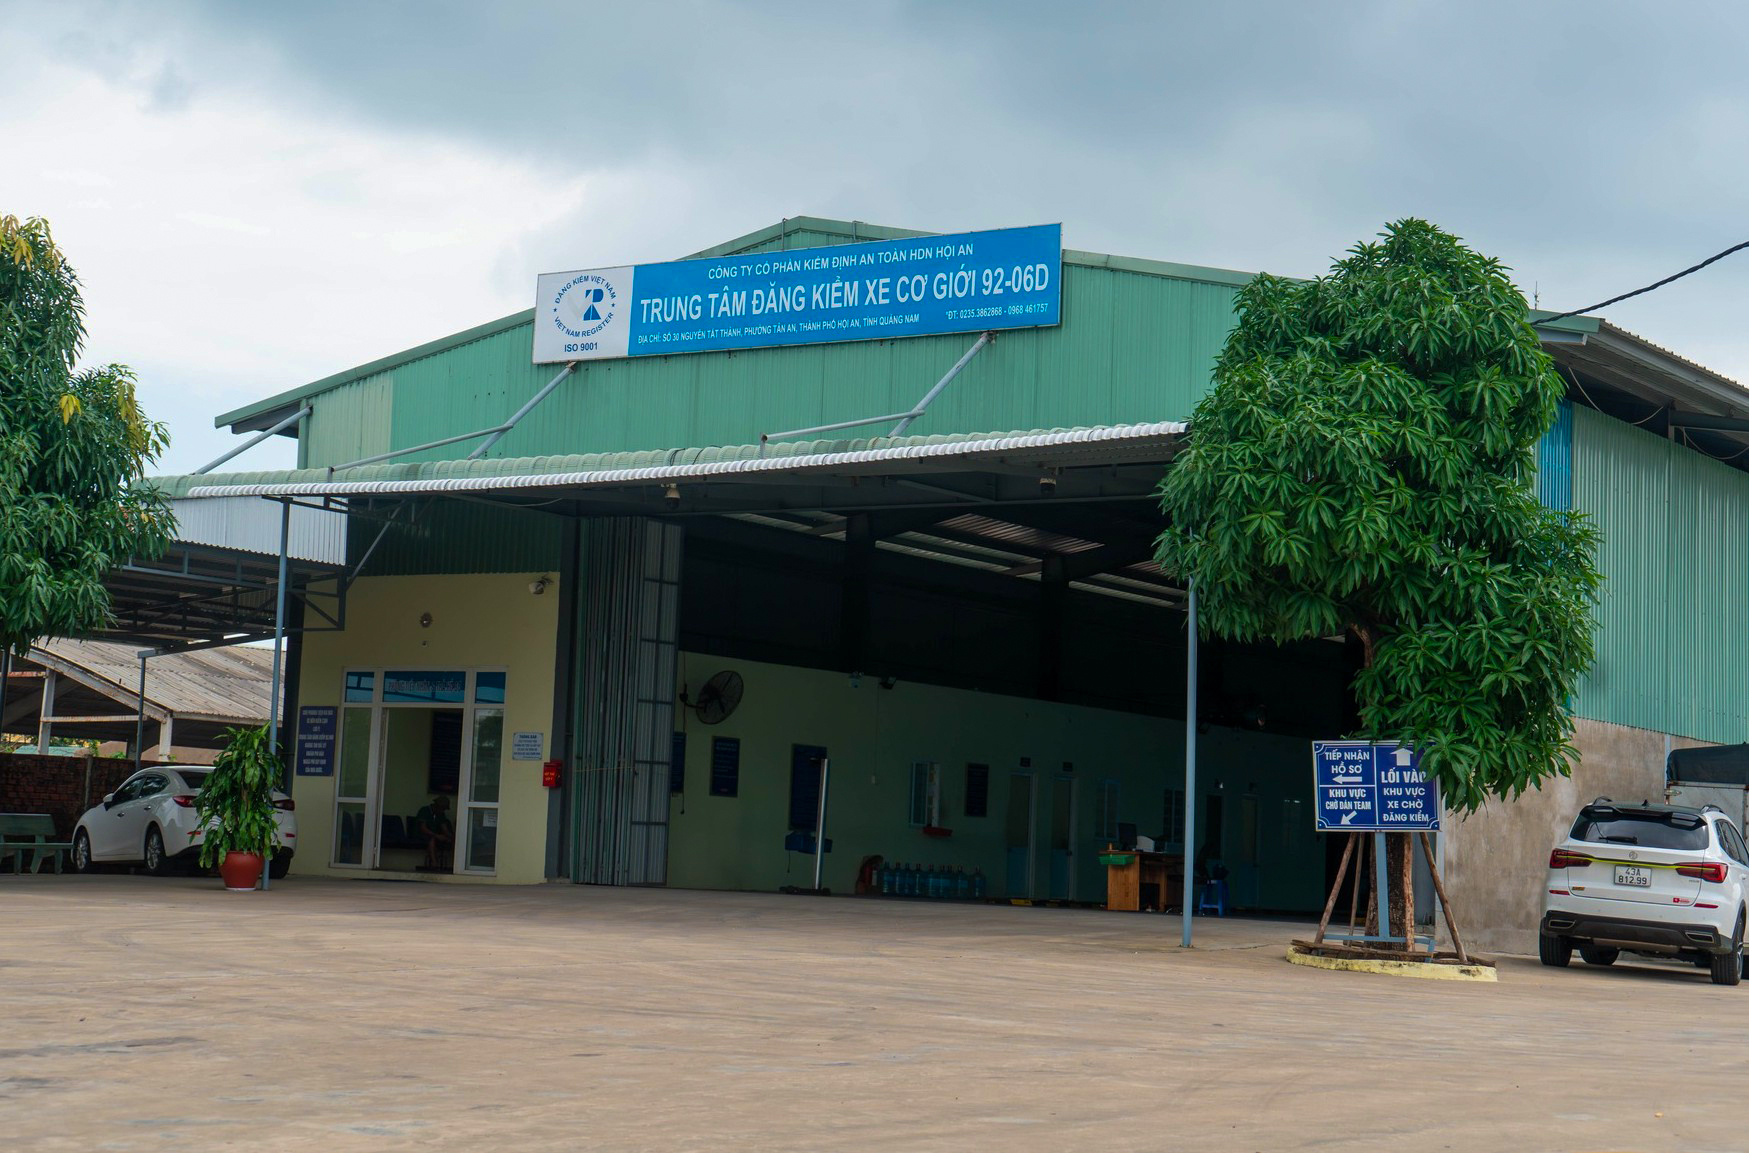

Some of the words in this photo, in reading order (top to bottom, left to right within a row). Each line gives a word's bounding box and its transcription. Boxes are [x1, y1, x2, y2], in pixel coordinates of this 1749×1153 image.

[709, 265, 737, 280] CÔNG
[741, 264, 753, 276] TY
[832, 254, 857, 270] ĐỊNH
[859, 253, 874, 266] AN
[878, 248, 907, 264] TOÀN
[910, 247, 933, 260] HDN
[936, 244, 955, 260] HỘI
[958, 244, 974, 256] AN
[604, 282, 617, 300] NAM
[640, 294, 702, 324] TRUNG
[708, 285, 747, 318] TÂM
[752, 281, 806, 314] ĐĂNG
[812, 276, 859, 310] KIỂM
[864, 278, 891, 306] XE
[896, 274, 928, 303] CƠ
[933, 263, 976, 300] GIỚI
[982, 264, 1049, 296] 92-06D
[1008, 304, 1024, 315] 0968
[1025, 303, 1048, 313] 461757
[566, 328, 580, 337] NAM
[582, 312, 614, 338] REGISTER
[672, 332, 680, 342] 30
[839, 319, 849, 330] HỘI
[904, 314, 920, 324] NAM
[564, 343, 578, 352] ISO
[580, 342, 598, 351] 9001
[1325, 748, 1342, 760] TIẾP
[1344, 750, 1370, 762] NHẬN
[1331, 760, 1346, 774] HỒ
[1348, 764, 1362, 774] SƠ
[1381, 767, 1400, 784] LỐI
[1329, 788, 1347, 798] KHU
[1348, 788, 1366, 800] VỰC
[1383, 788, 1402, 796] KHU
[1404, 787, 1426, 798] VỰC
[1326, 799, 1338, 810] CHỜ
[1354, 801, 1372, 810] TEAM
[1387, 801, 1400, 809] XE
[1401, 799, 1424, 809] CHỜ
[1382, 812, 1408, 822] ĐĂNG
[1409, 810, 1429, 822] KIỂM
[1625, 868, 1641, 876] 43A
